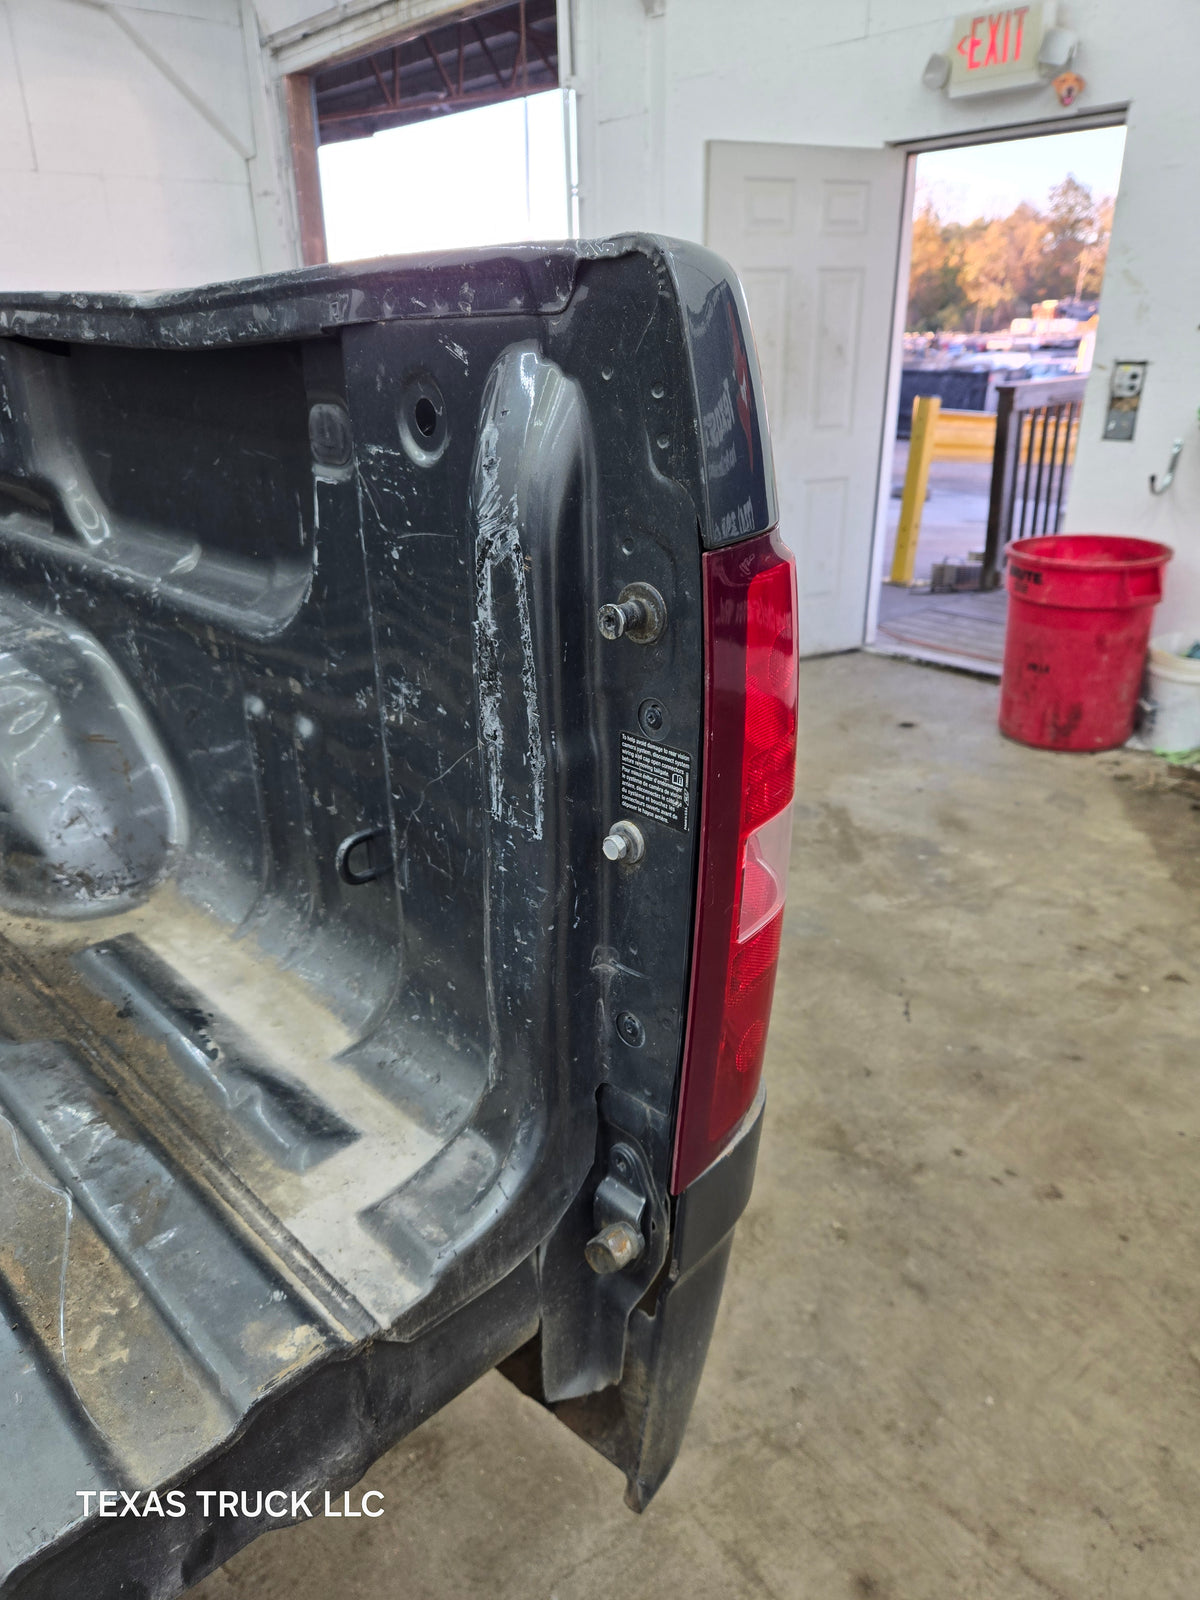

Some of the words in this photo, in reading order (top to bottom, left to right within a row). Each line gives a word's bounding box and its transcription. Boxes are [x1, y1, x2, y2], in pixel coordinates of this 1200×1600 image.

[967, 6, 1029, 70] EXIT
[622, 742, 636, 750] camera
[653, 752, 674, 764] disconnect
[675, 760, 690, 769] system
[622, 755, 634, 764] before
[622, 749, 634, 758] wiring
[662, 763, 684, 775] connectors
[647, 743, 663, 752] damage
[678, 753, 689, 761] vision
